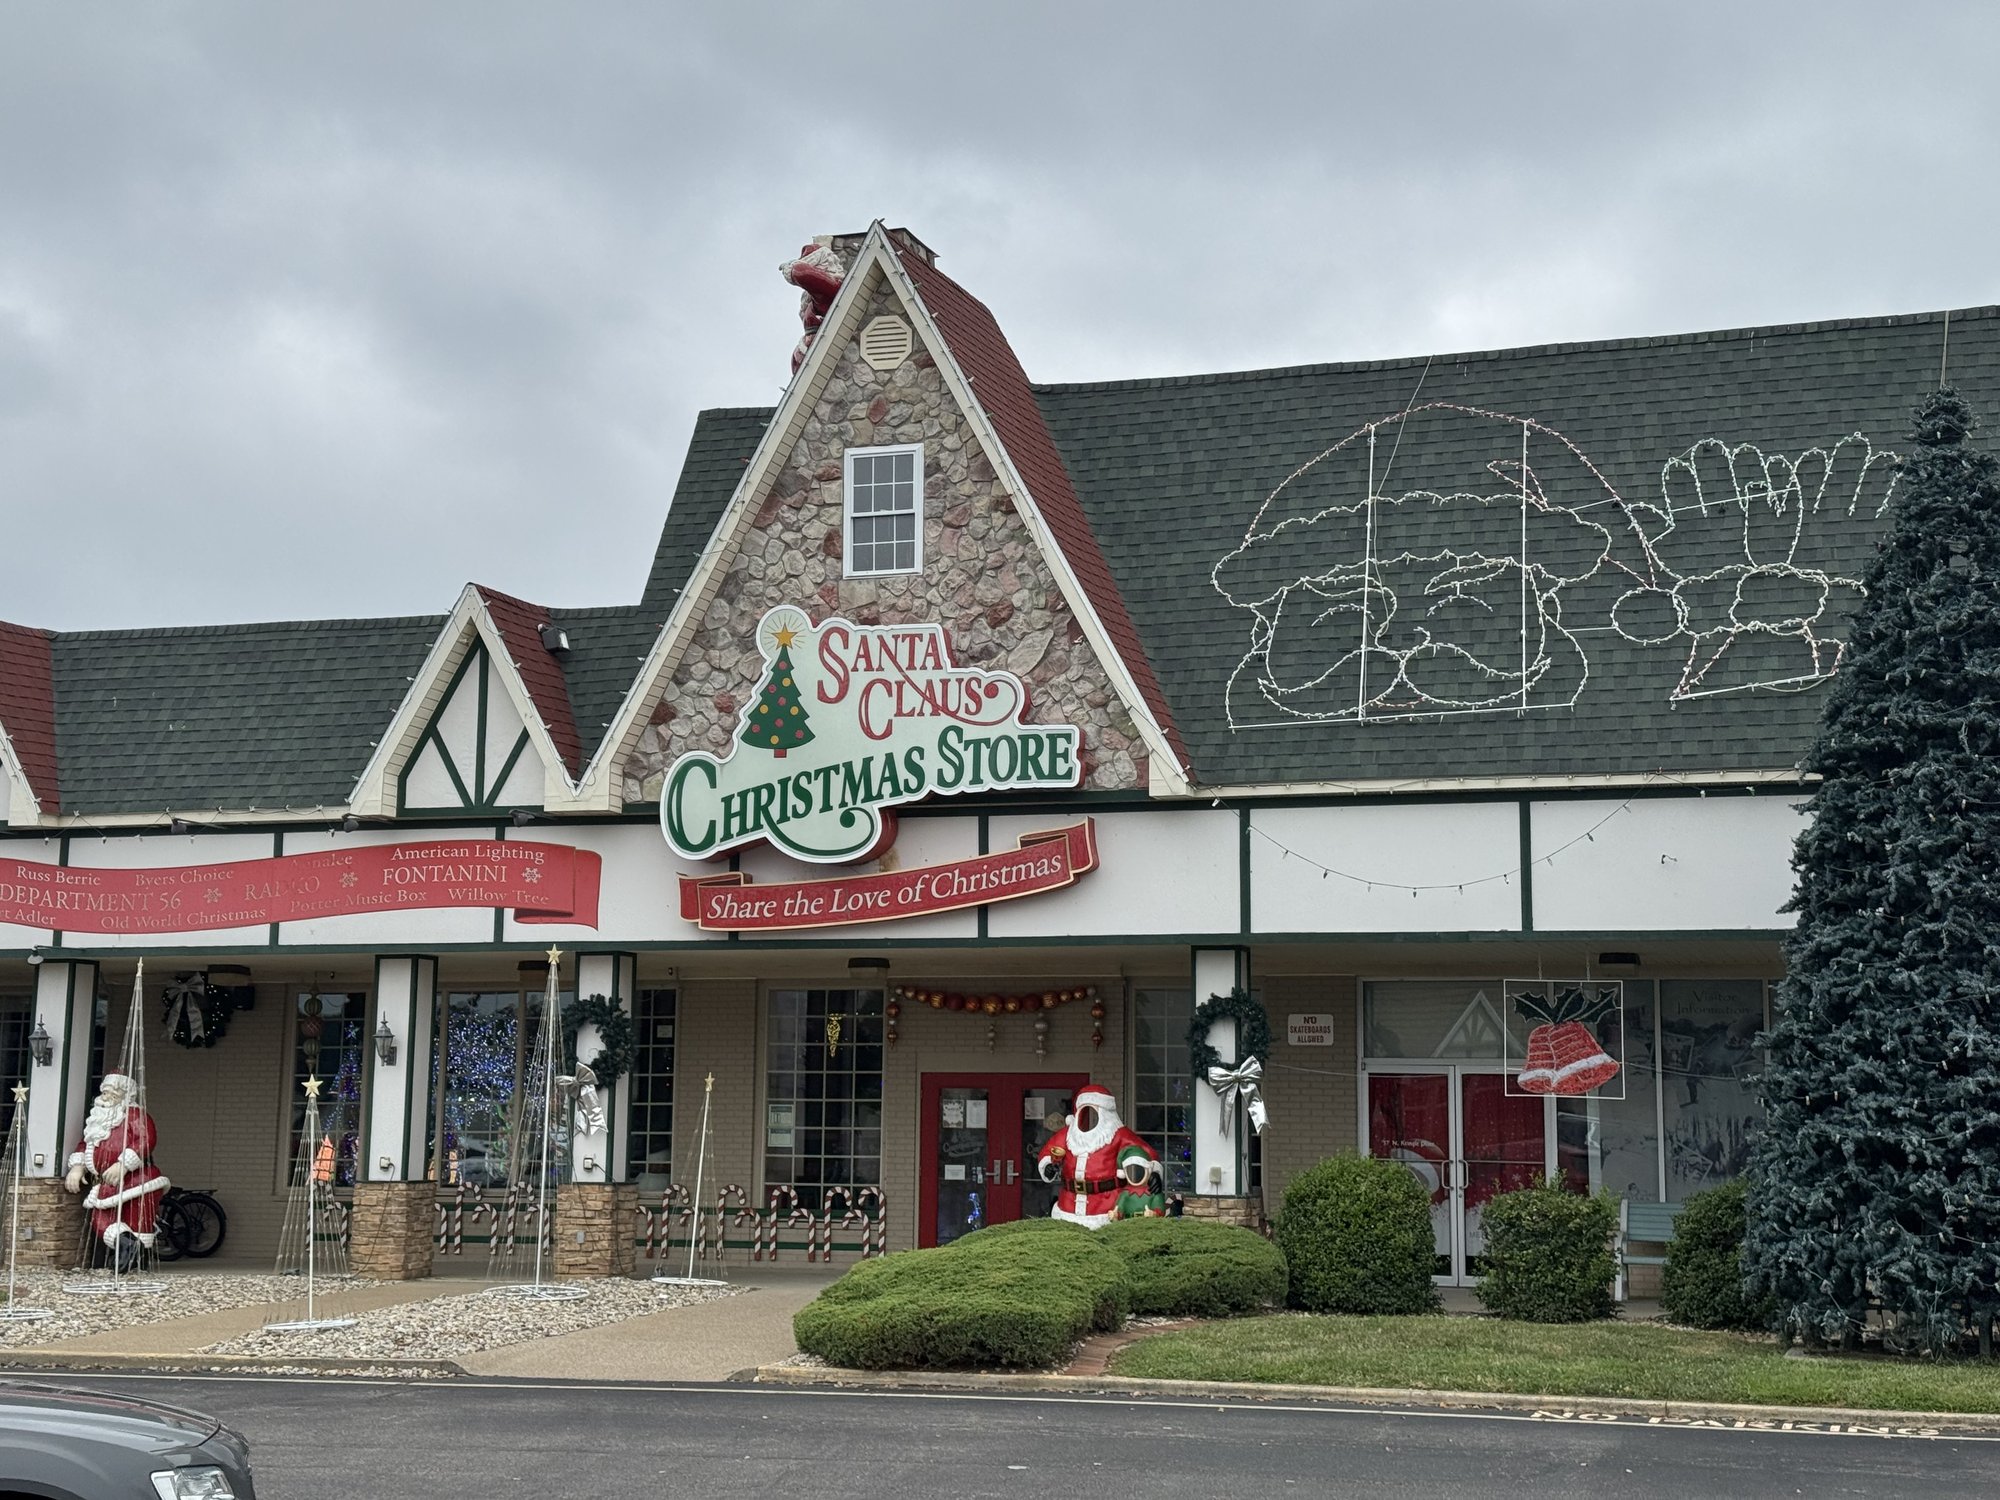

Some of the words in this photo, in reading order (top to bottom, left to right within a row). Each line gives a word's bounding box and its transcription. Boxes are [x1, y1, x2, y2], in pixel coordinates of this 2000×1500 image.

[817, 627, 950, 708] SANTA
[858, 677, 984, 741] CLAUS
[667, 745, 926, 856] CHRISTMAS
[936, 725, 1074, 788] STORE
[390, 845, 471, 862] American
[475, 844, 545, 864] Lighting
[16, 865, 51, 883] Russ
[55, 870, 101, 887] Berrie
[135, 873, 176, 891] Byers
[180, 868, 235, 883] Choice
[382, 865, 508, 886] FONTANINI
[345, 890, 393, 907] Music
[397, 888, 428, 902] Box
[447, 887, 509, 902] Willow
[512, 889, 551, 905] Tree
[706, 894, 777, 921] Share
[782, 889, 824, 917] the
[828, 882, 891, 914] Love
[896, 871, 932, 904] of
[929, 853, 1063, 900] Christmas
[0, 883, 152, 913] DEPARTMENT
[159, 889, 183, 911] 56
[14, 908, 57, 926] Adler
[101, 915, 130, 930] Old
[134, 914, 182, 929] World
[186, 907, 267, 926] Christmas
[1289, 1025, 1331, 1034] SKATEBOARDS
[1303, 1016, 1317, 1024] NO
[1297, 1035, 1324, 1043] ALLOWED
